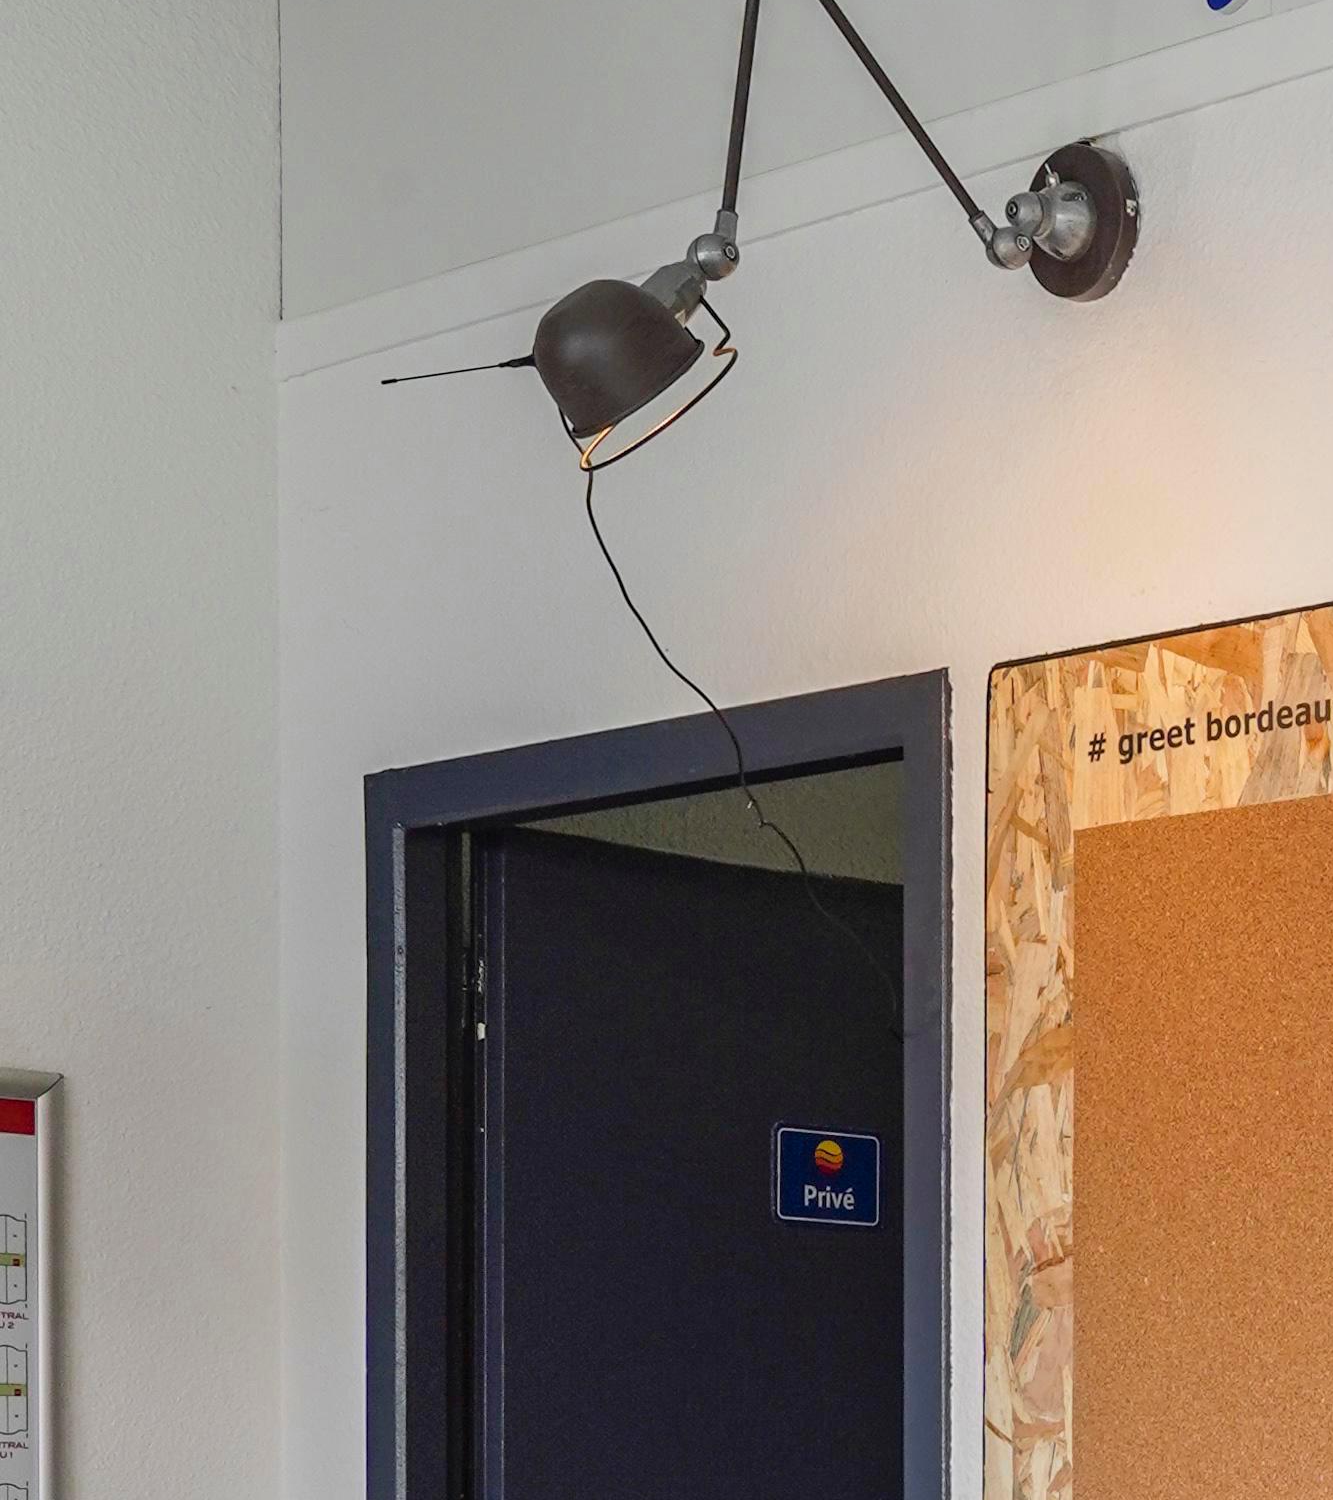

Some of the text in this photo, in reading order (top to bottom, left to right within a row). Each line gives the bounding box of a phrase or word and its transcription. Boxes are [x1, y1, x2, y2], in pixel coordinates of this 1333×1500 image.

[1087, 731, 1107, 763] #
[1117, 716, 1196, 765] greet
[803, 1184, 856, 1211] Privé
[0, 1310, 29, 1321] TRAL
[0, 1441, 29, 1450] TRAL
